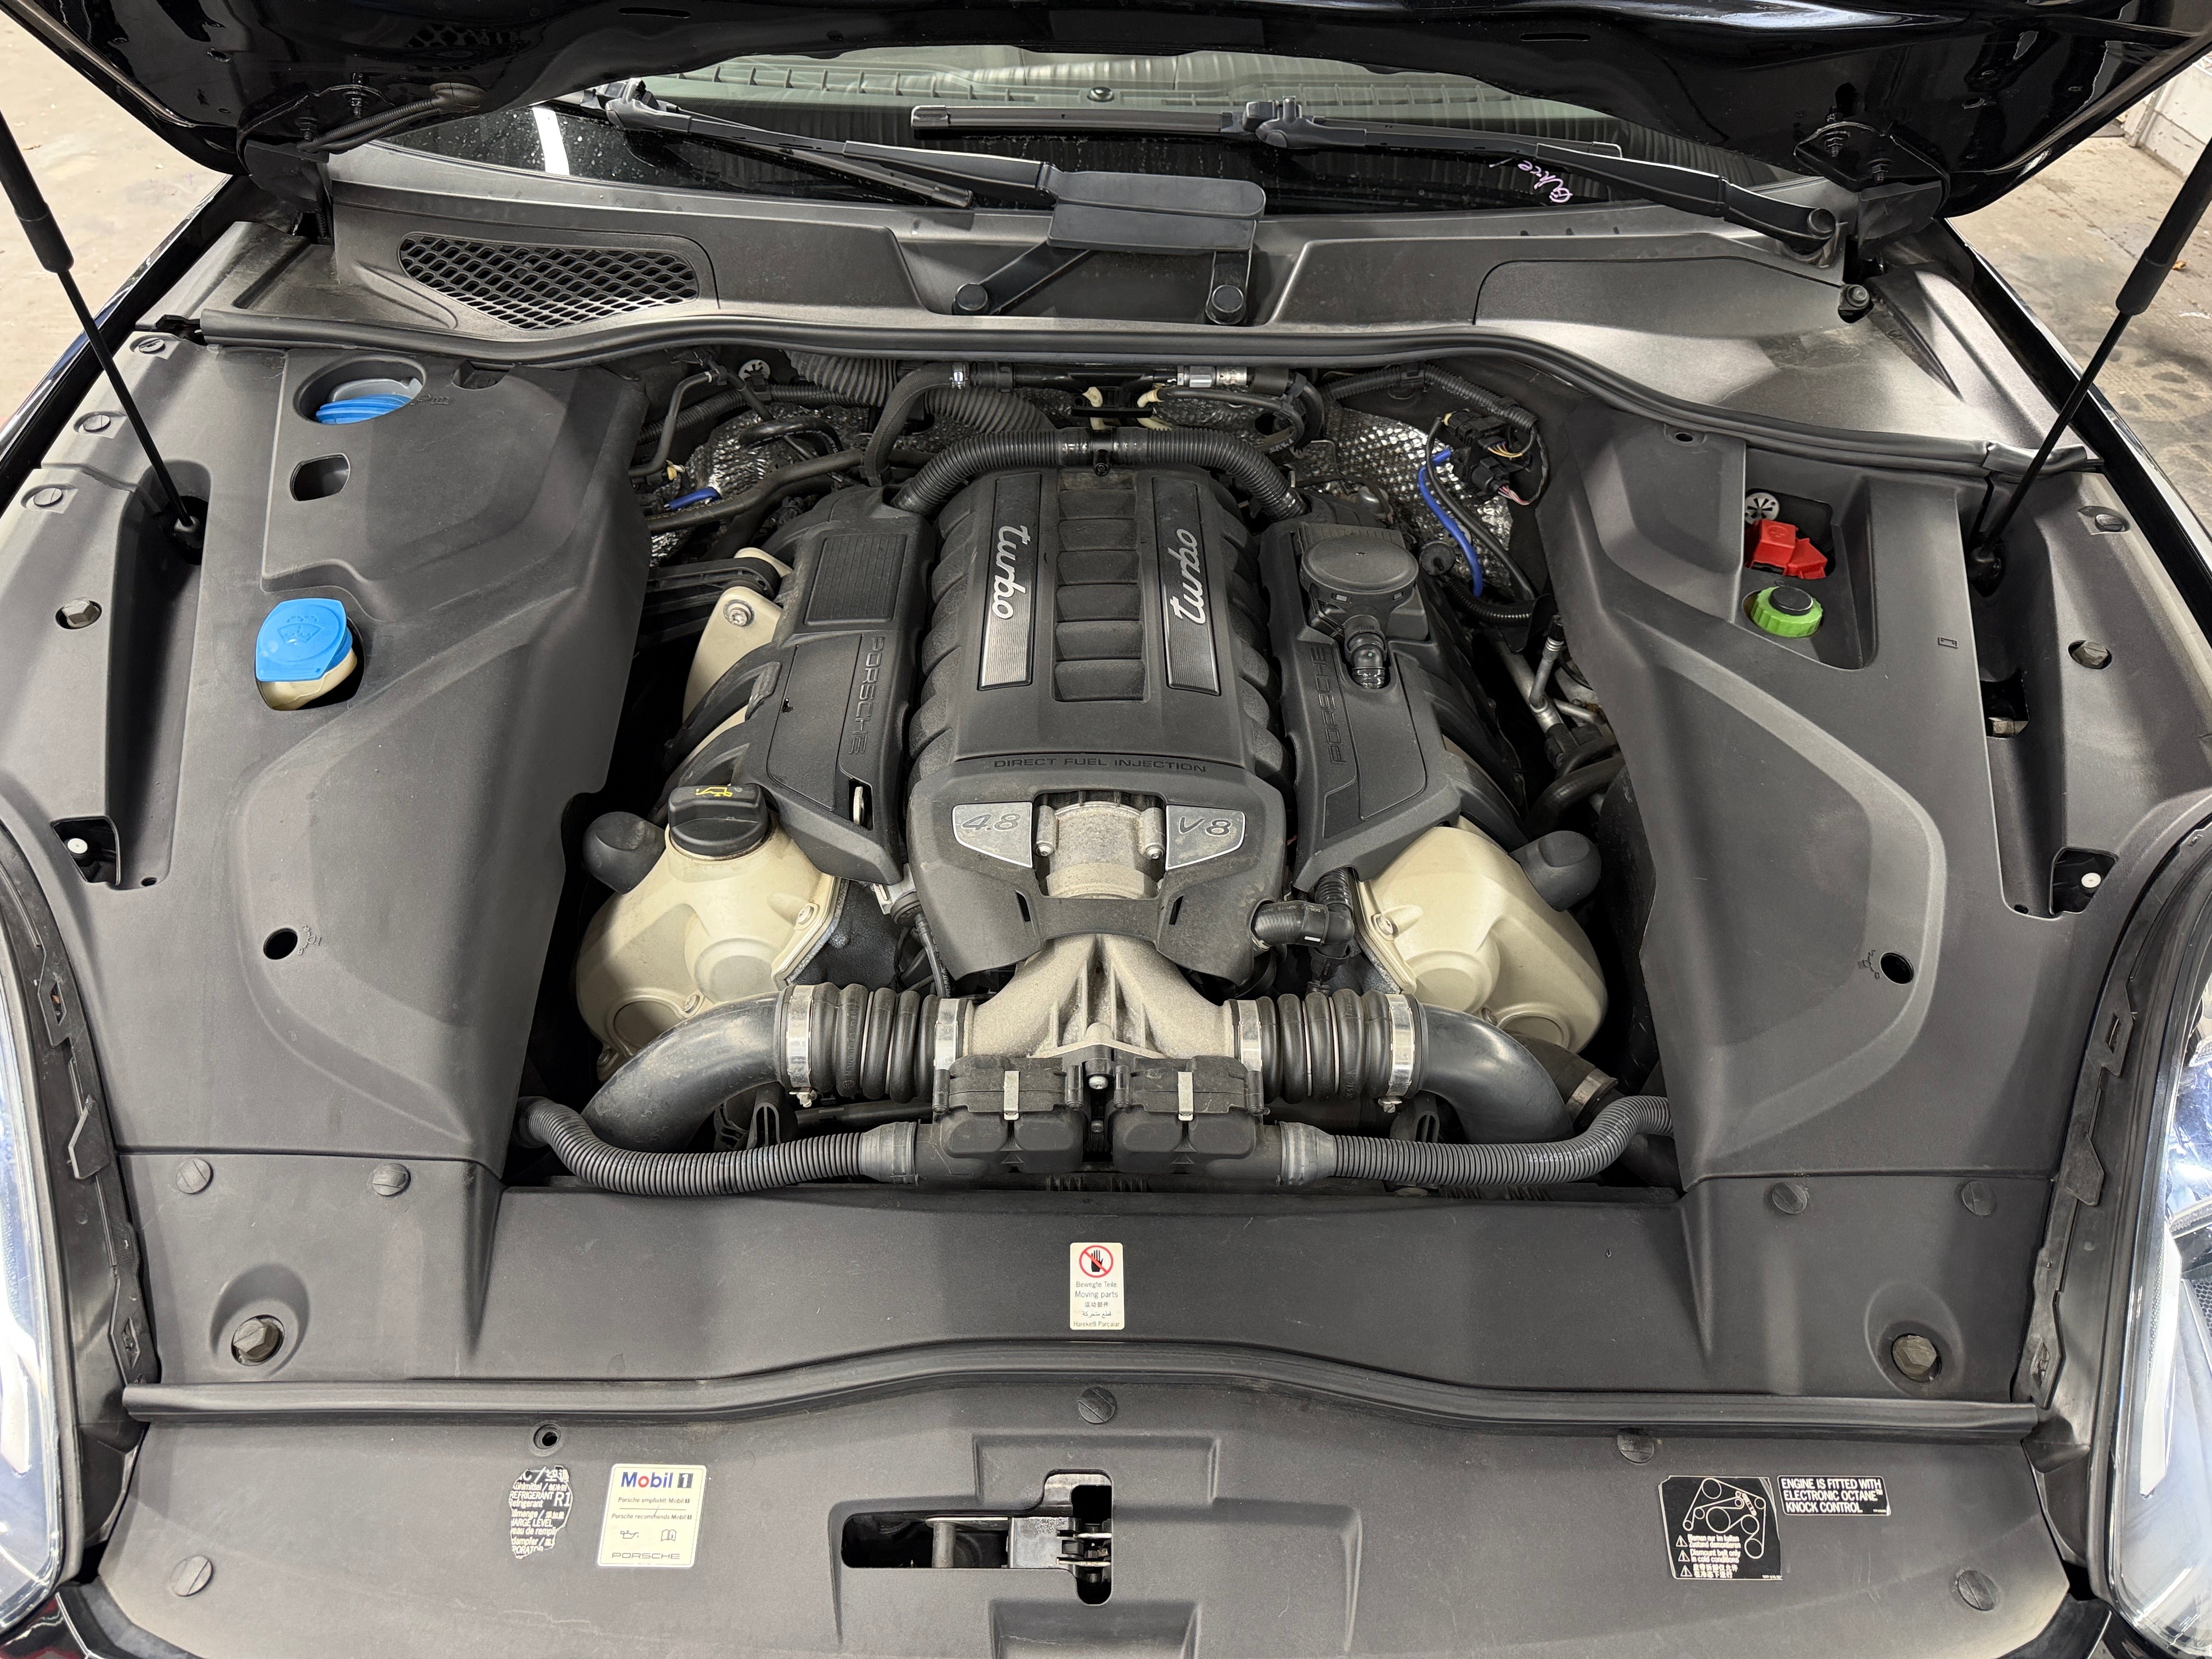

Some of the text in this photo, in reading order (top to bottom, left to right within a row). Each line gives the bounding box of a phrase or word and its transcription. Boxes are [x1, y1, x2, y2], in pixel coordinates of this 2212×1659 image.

[992, 525, 1031, 619] turbo
[1167, 528, 1206, 625] turbo
[849, 636, 884, 755] PORSCHE
[1311, 647, 1346, 764] PORSCHE
[994, 758, 1057, 768] DIRECT
[1114, 759, 1206, 772] INJECTION
[961, 812, 1021, 832] 4.8
[1075, 1291, 1099, 1299] Moving
[620, 1472, 692, 1488] Mobil 1
[1781, 1479, 1882, 1489] ENGINE IS FITTED WITH
[510, 1491, 554, 1500] REFRIGERANT
[1783, 1490, 1840, 1501] ELECTRONIC
[1786, 1502, 1863, 1513] KNOCK CONTROL
[533, 1519, 553, 1527] LEVEL
[1729, 1550, 1741, 1558] only
